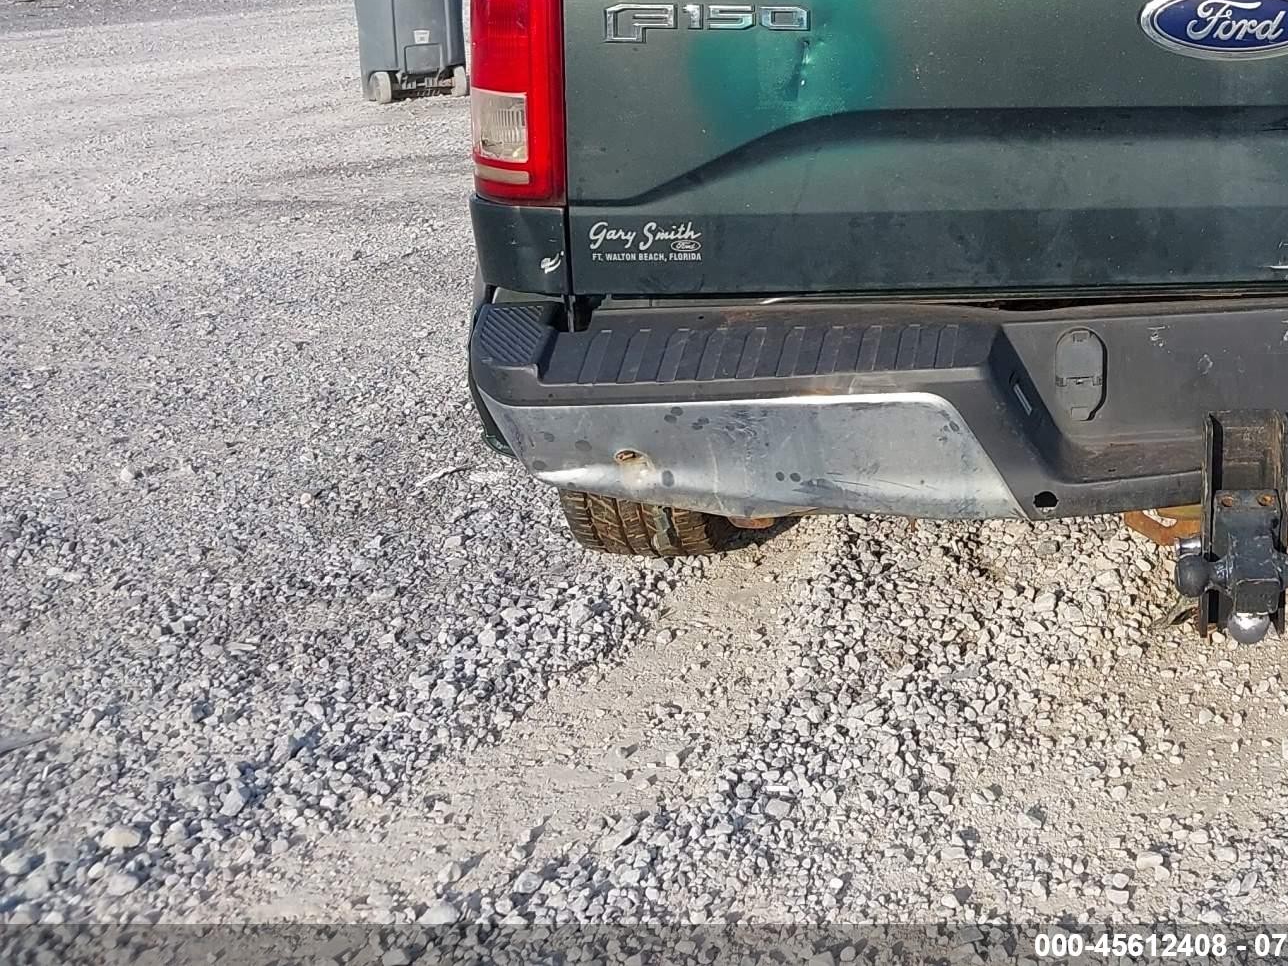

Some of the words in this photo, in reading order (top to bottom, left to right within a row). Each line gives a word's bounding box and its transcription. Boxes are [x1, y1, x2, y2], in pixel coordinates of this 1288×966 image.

[1186, 0, 1286, 41] Ford
[589, 221, 636, 249] Gary
[639, 221, 702, 250] Smith
[592, 253, 603, 261] FT.
[605, 253, 636, 261] WALTON
[638, 253, 667, 262] BEACH,
[669, 253, 702, 261] FLORIDA
